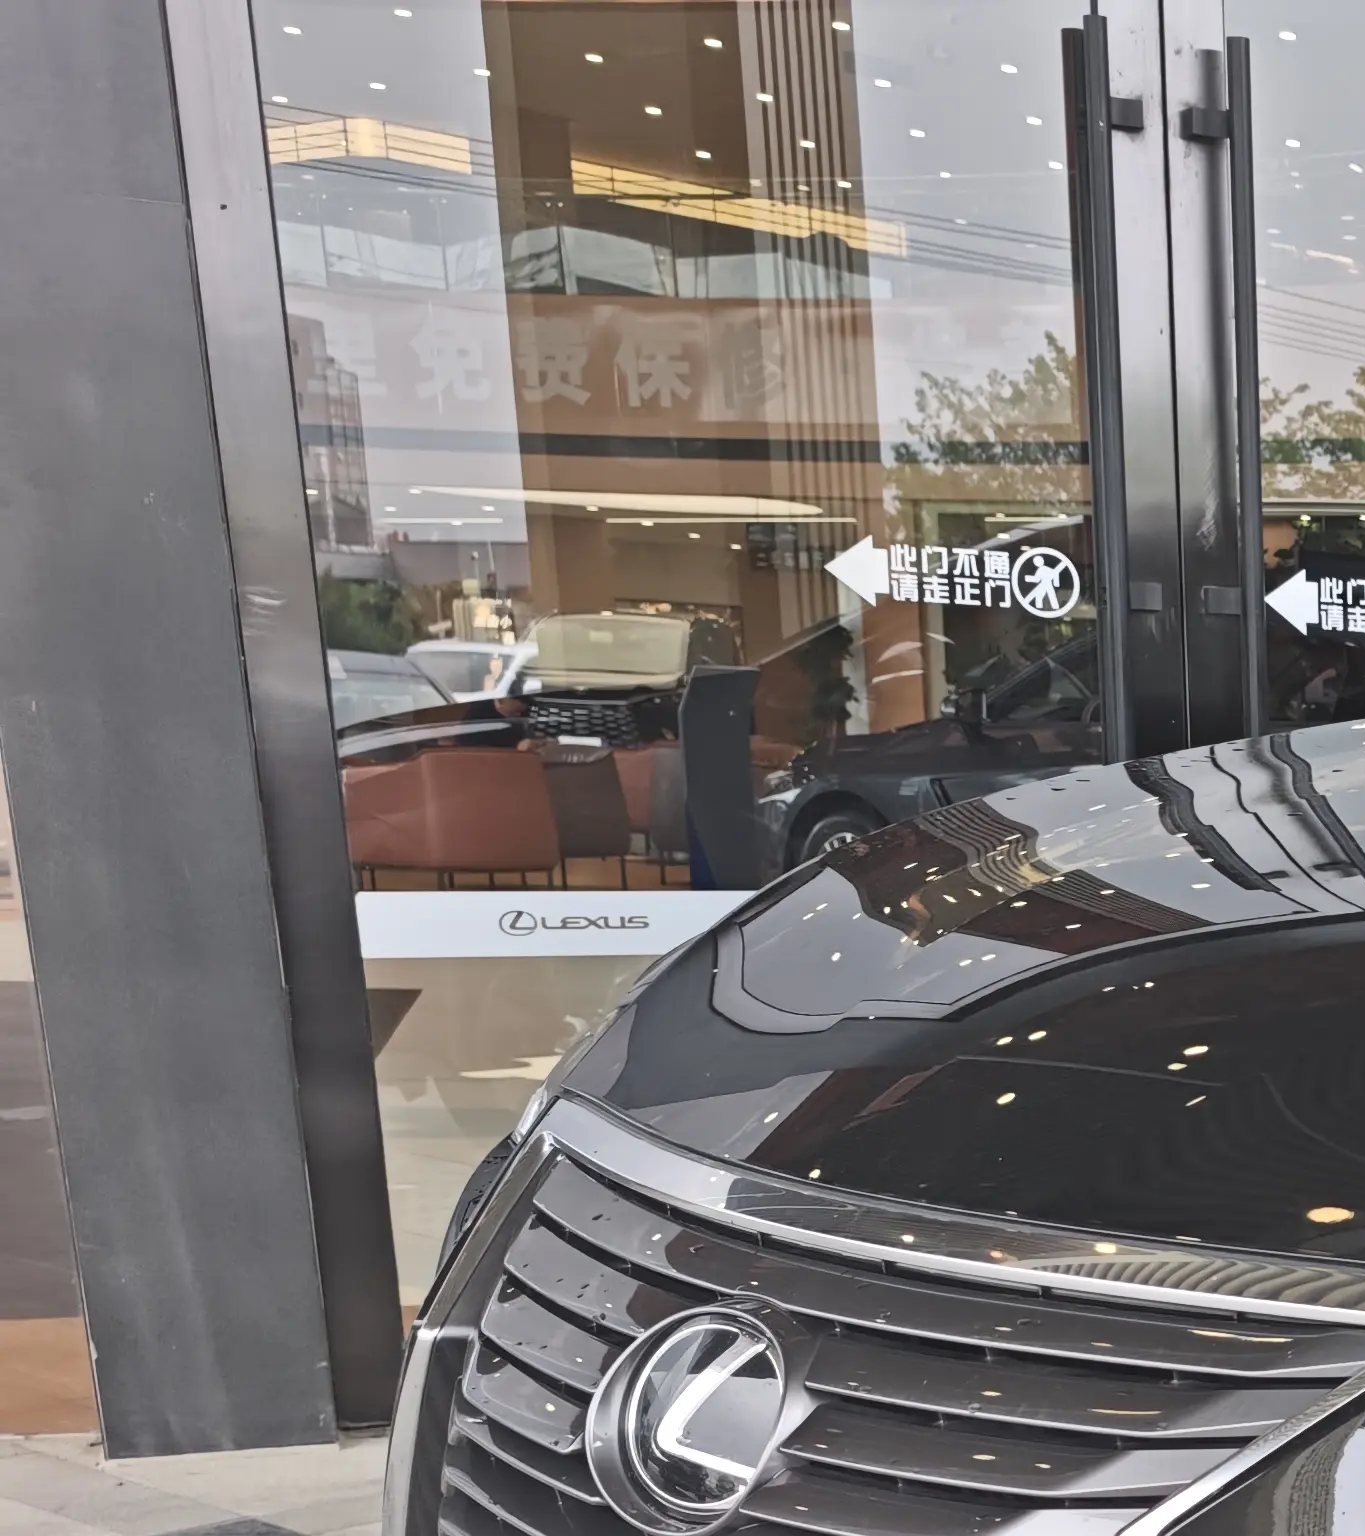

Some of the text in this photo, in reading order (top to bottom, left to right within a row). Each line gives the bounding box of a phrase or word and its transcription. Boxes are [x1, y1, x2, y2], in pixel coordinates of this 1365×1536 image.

[889, 544, 1010, 576] 此门不通
[891, 574, 1012, 608] 请走正门
[540, 914, 649, 930] LEXUS
